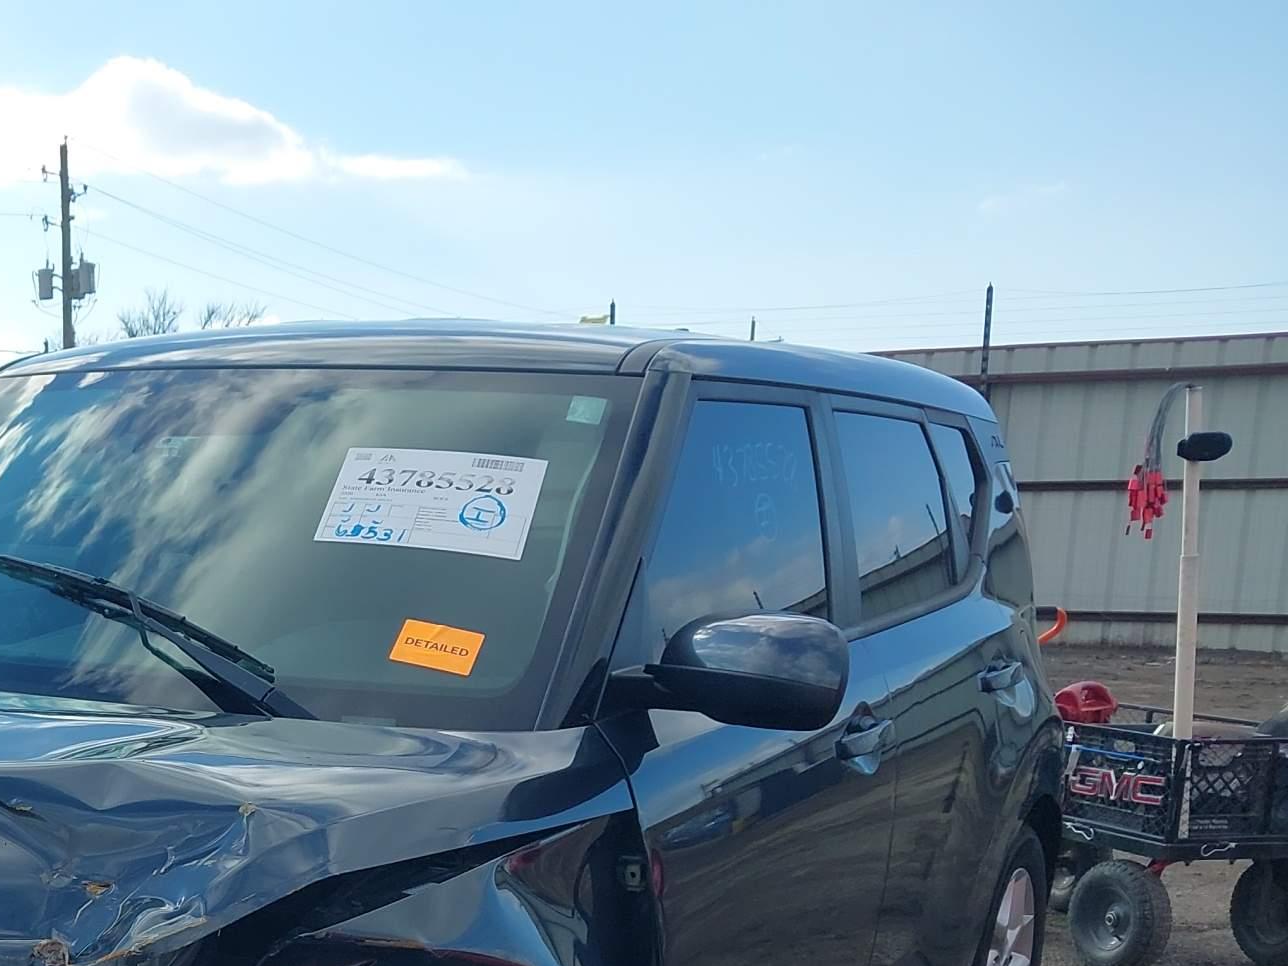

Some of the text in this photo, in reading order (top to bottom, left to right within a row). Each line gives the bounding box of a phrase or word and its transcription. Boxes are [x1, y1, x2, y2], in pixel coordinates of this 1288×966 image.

[357, 467, 517, 497] 43785528
[404, 636, 469, 657] DETAILED
[1069, 765, 1167, 806] GMC
